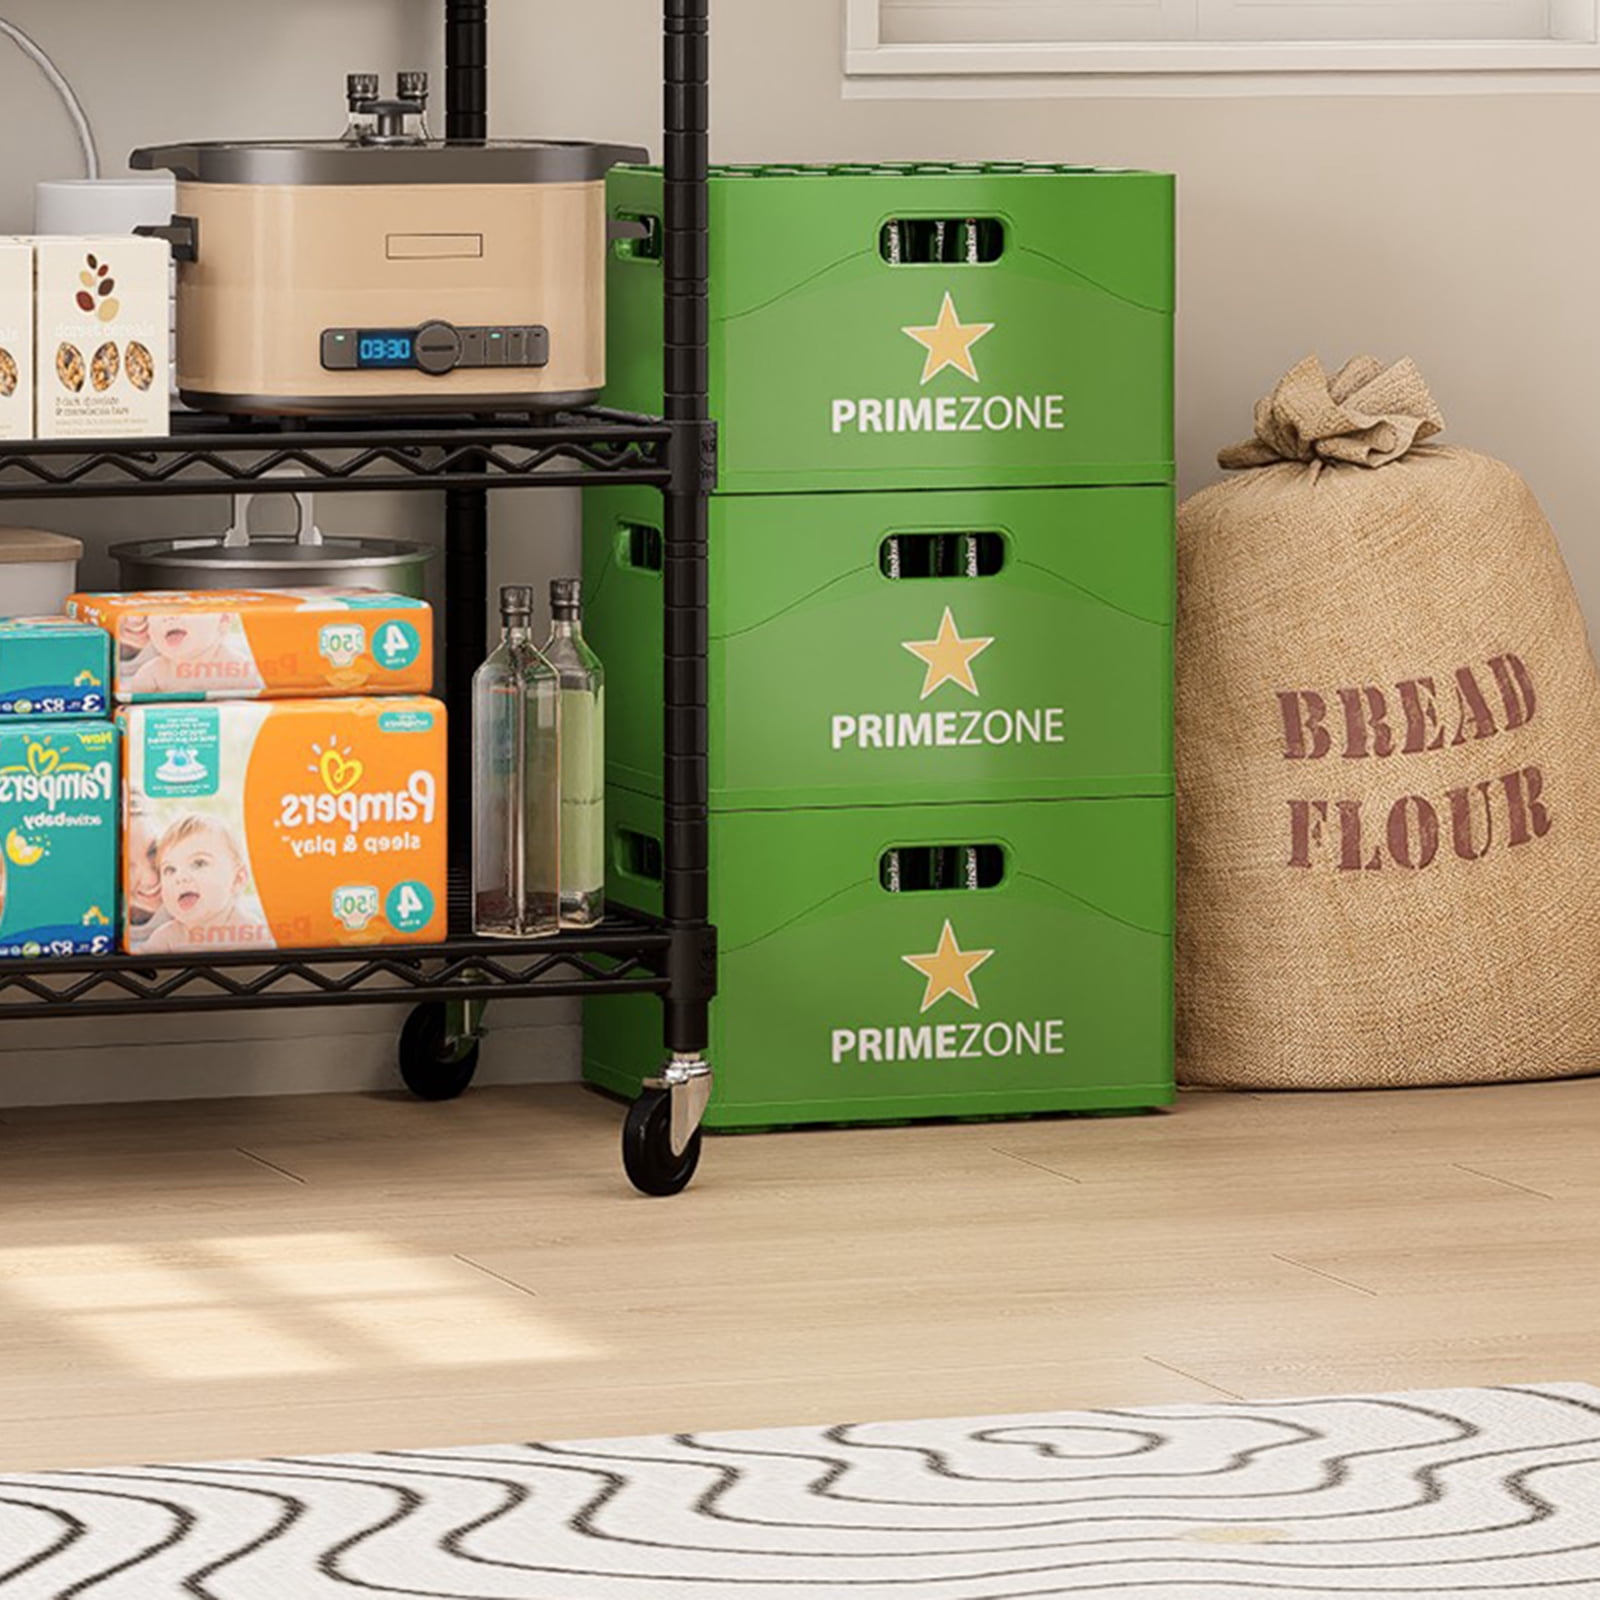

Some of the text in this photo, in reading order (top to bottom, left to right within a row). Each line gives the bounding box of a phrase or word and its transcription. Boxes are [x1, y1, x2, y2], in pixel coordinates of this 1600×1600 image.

[360, 339, 410, 360] 03:30
[832, 395, 1063, 433] PRIMEZONE
[1275, 653, 1537, 760] BREAD
[832, 708, 1063, 749] PRIMEZONE
[1286, 765, 1552, 870] FLOUR
[832, 1020, 1063, 1062] PRIMEZONE
